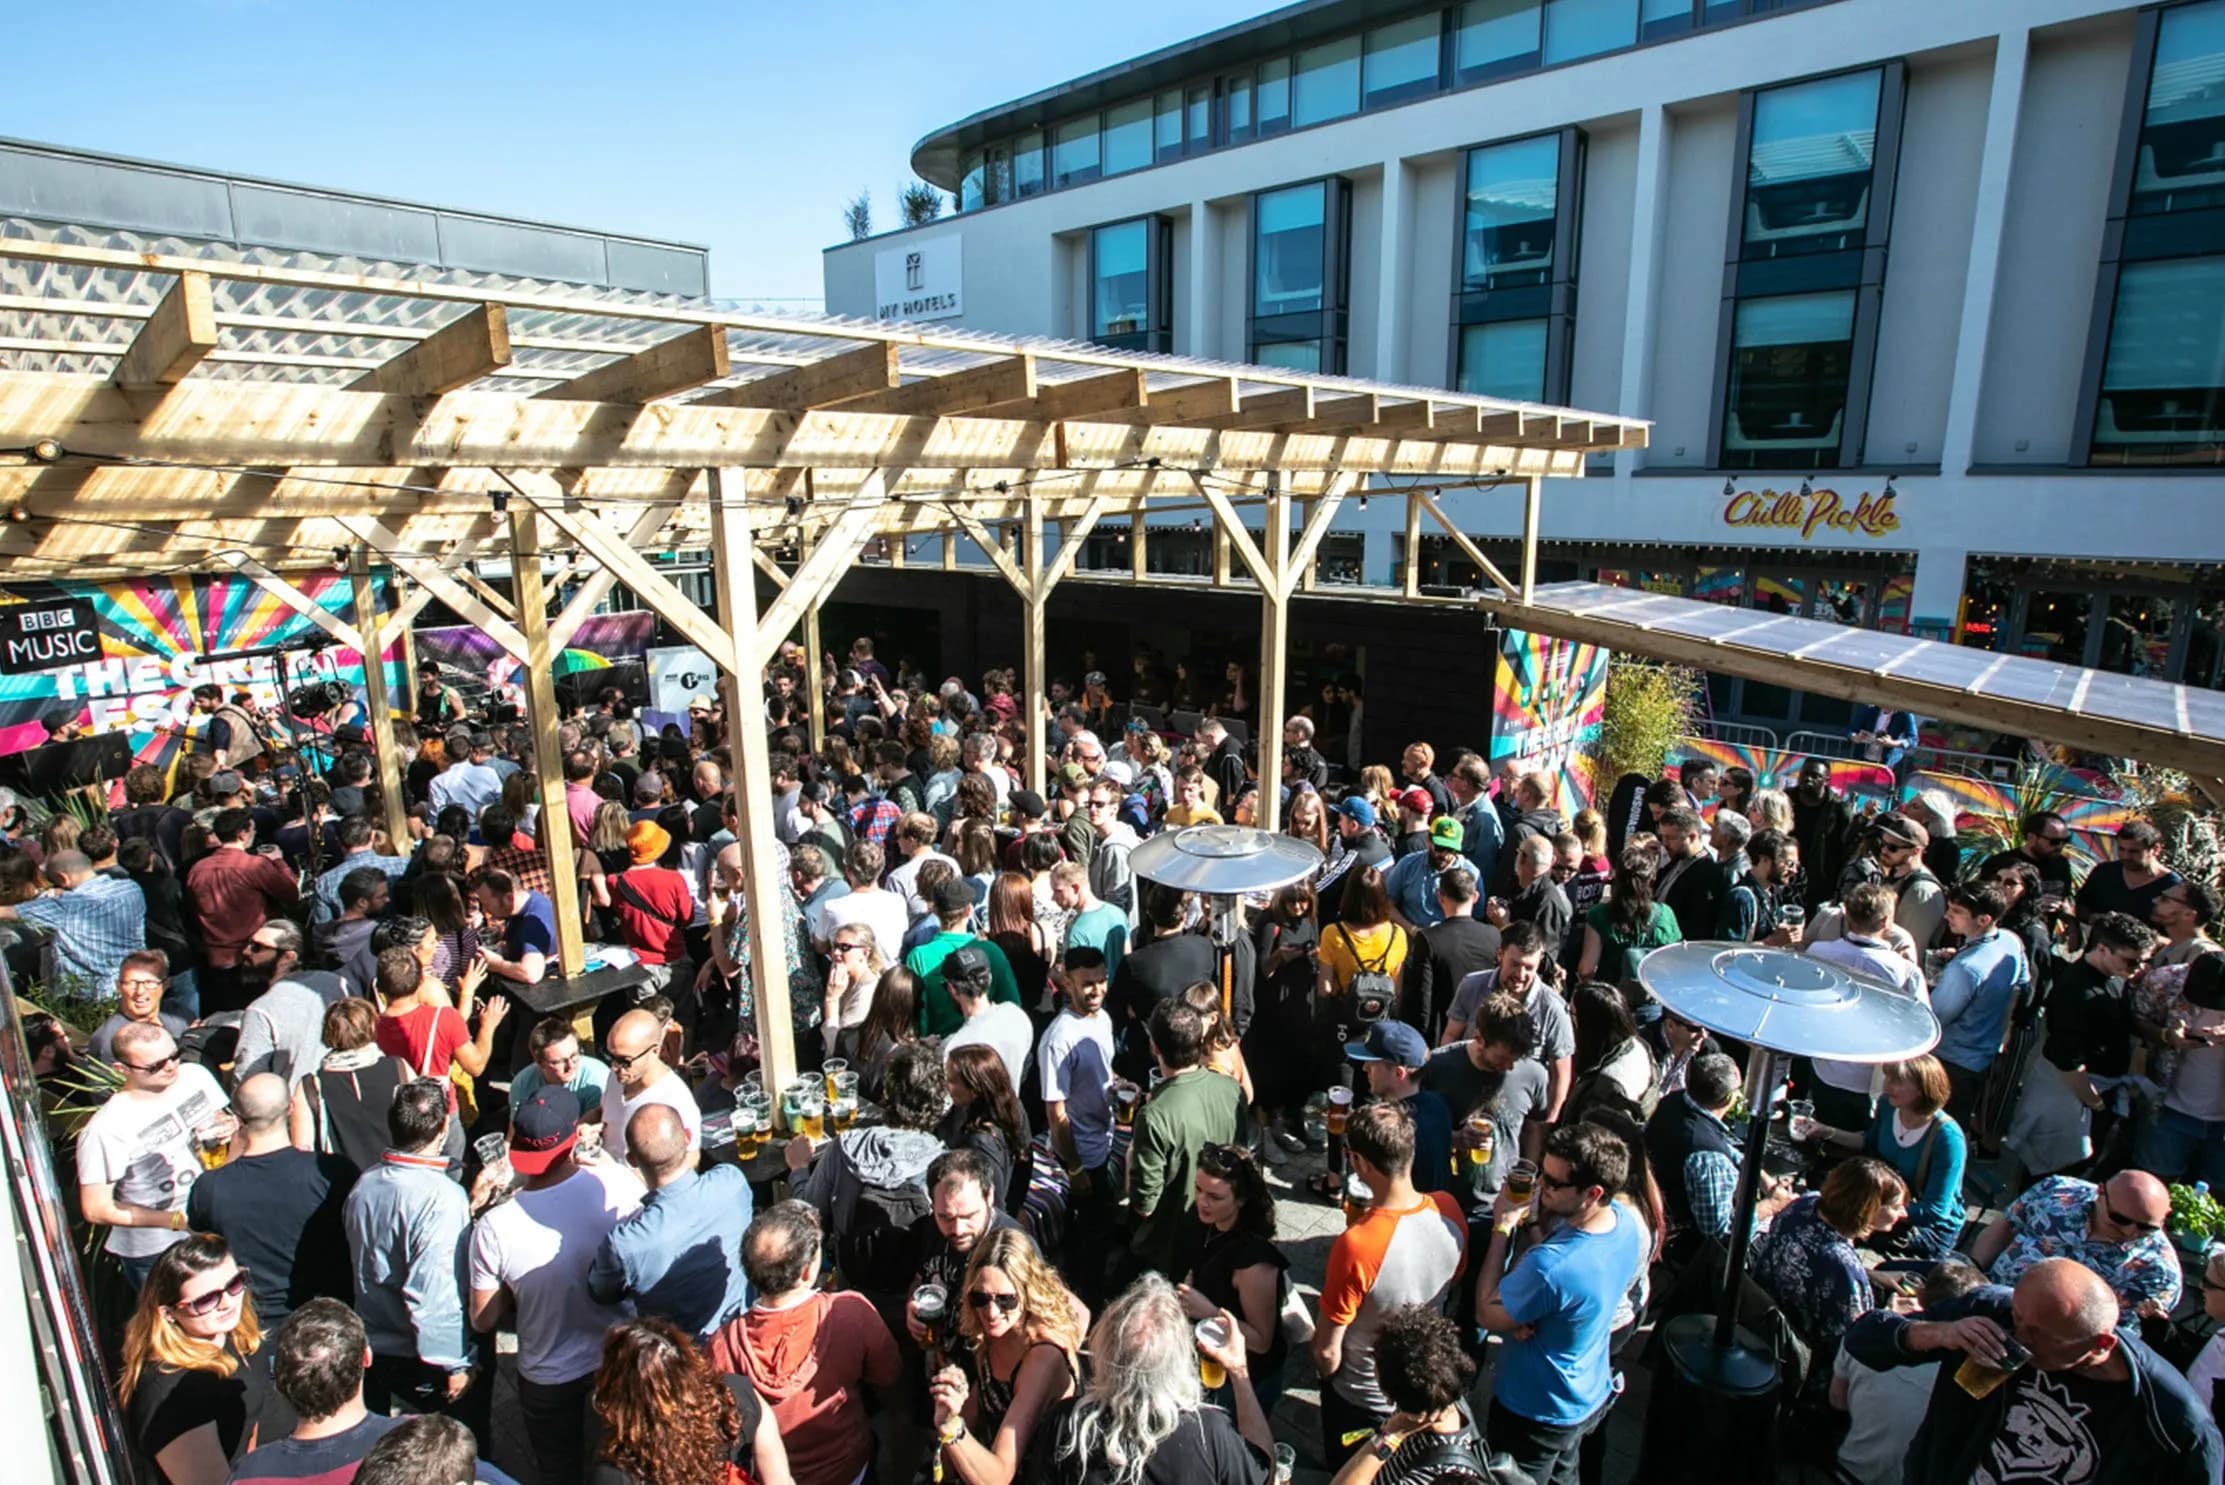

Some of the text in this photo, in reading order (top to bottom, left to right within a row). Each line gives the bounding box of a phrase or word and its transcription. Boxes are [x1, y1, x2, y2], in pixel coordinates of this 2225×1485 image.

[903, 293, 956, 315] HOTELS
[1723, 488, 1900, 540] Chilli Pickle
[20, 609, 75, 631] BBC
[8, 630, 97, 664] MUSIC
[43, 655, 166, 700] THE
